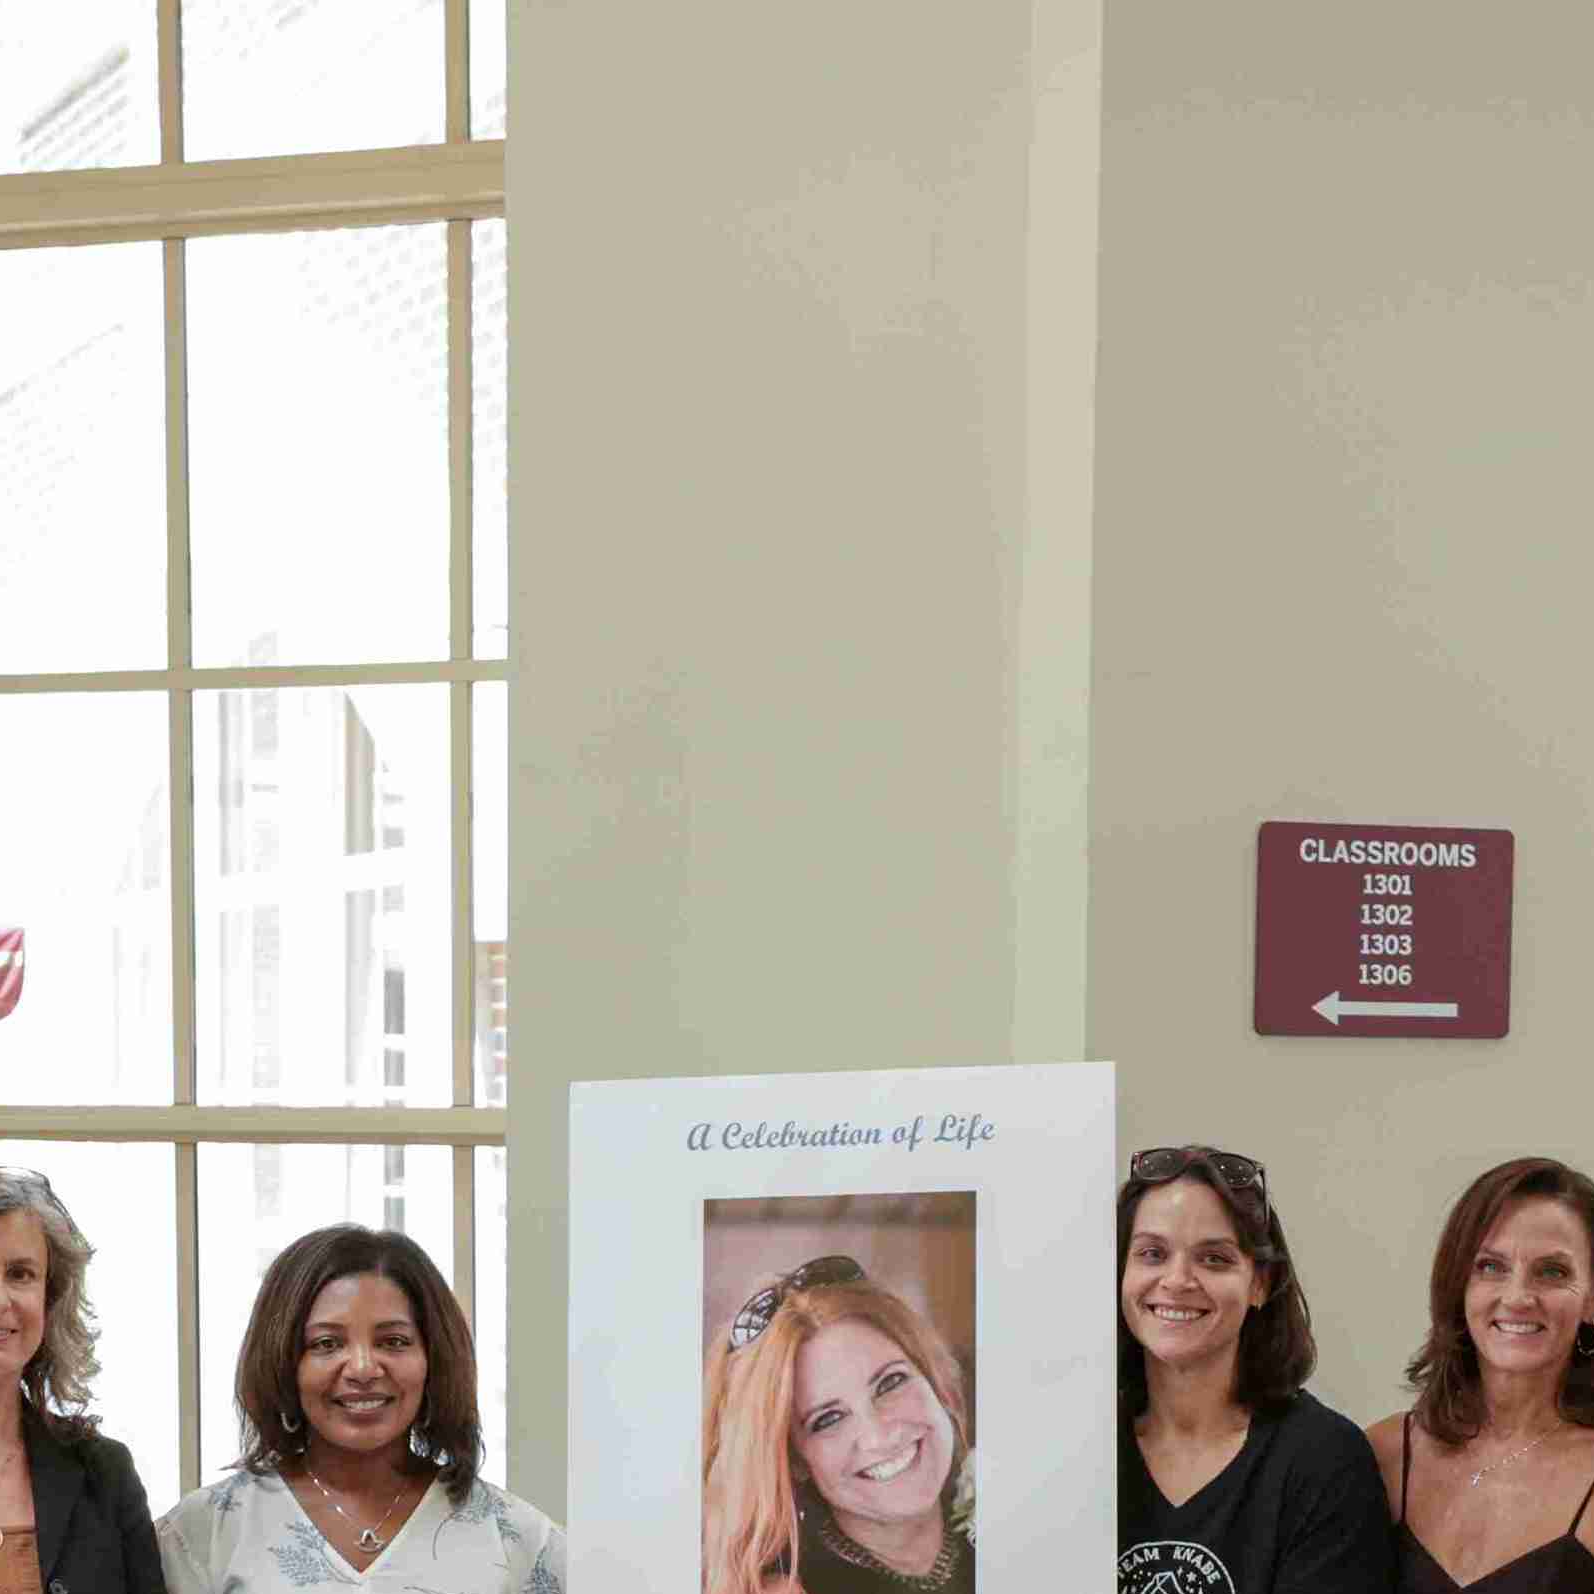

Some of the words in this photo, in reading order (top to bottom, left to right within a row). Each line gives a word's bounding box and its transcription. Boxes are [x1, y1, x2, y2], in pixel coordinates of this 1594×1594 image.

[1299, 838, 1477, 868] CLASSROOMS
[1362, 873, 1413, 896] 1301
[1360, 904, 1413, 926] 1302
[1359, 934, 1413, 956] 1303
[1358, 964, 1413, 986] 1306
[686, 1122, 711, 1151] A
[721, 1121, 882, 1150] Celebration
[891, 1114, 924, 1151] of
[933, 1113, 995, 1150] Life
[1173, 1546, 1221, 1585] KNABE
